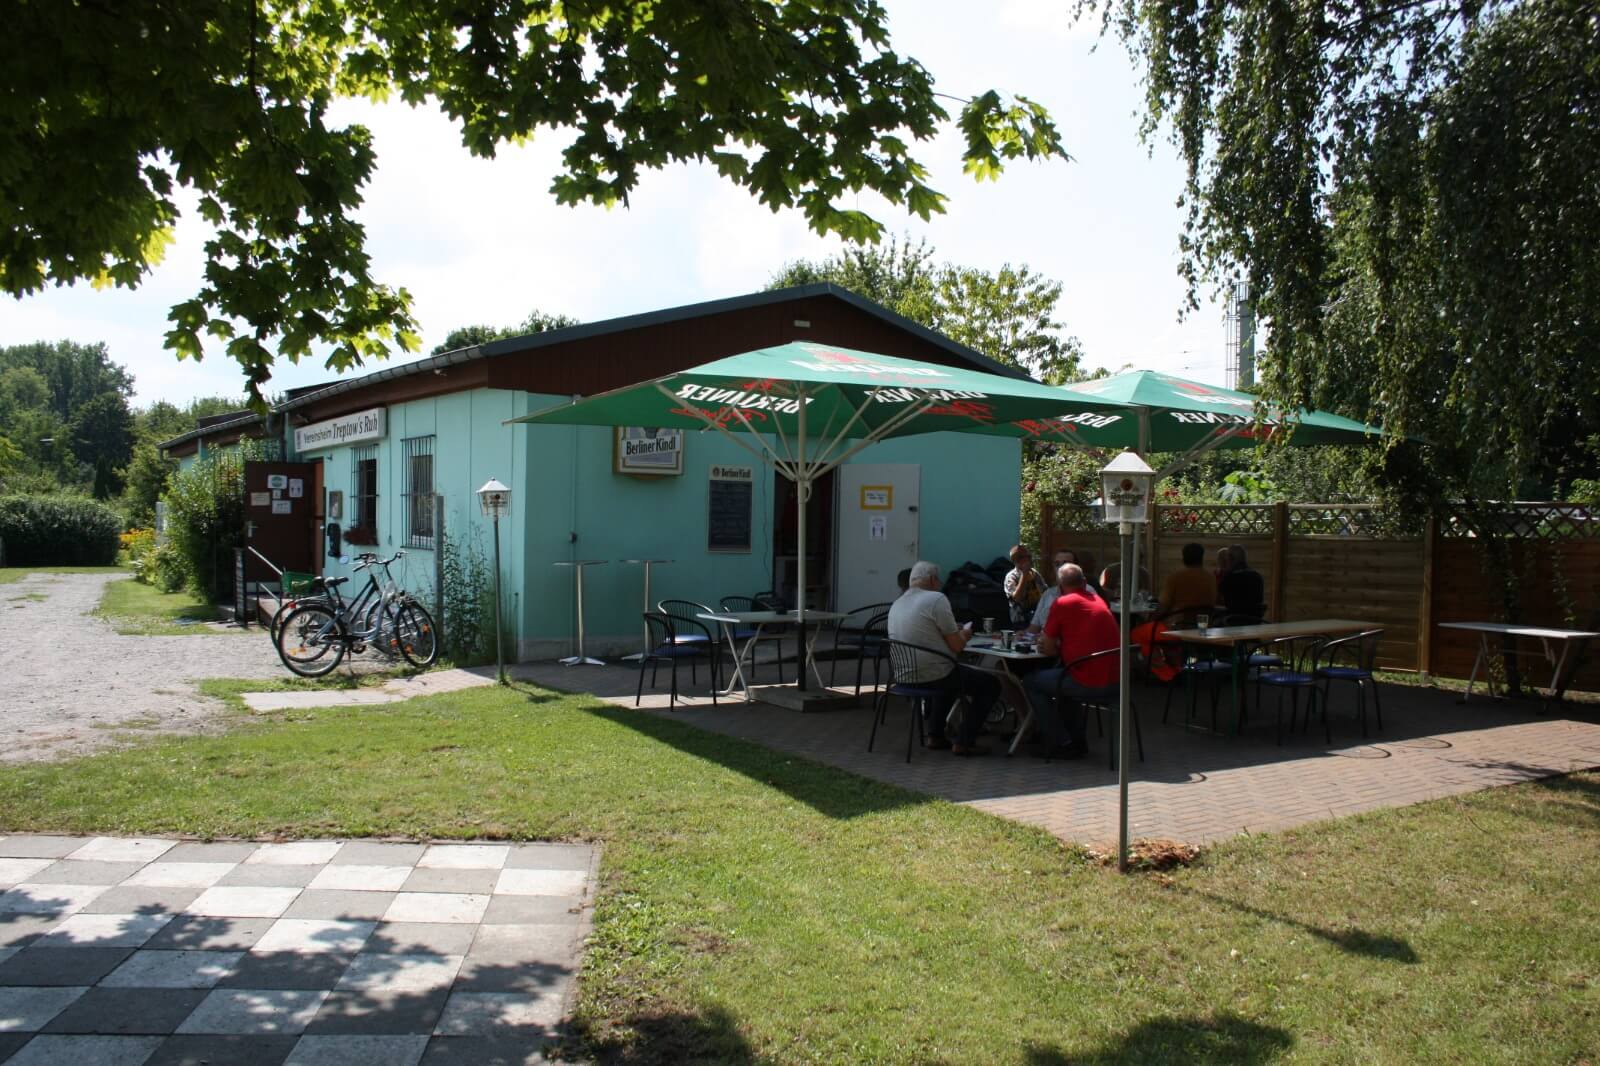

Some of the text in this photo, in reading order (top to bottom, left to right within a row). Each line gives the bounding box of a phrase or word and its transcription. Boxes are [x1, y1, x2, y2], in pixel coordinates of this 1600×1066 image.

[303, 413, 378, 444] Vereinsheim Treptow's Ruh
[626, 437, 676, 455] Berliner Kindl
[721, 468, 751, 478] Berliner Kindl
